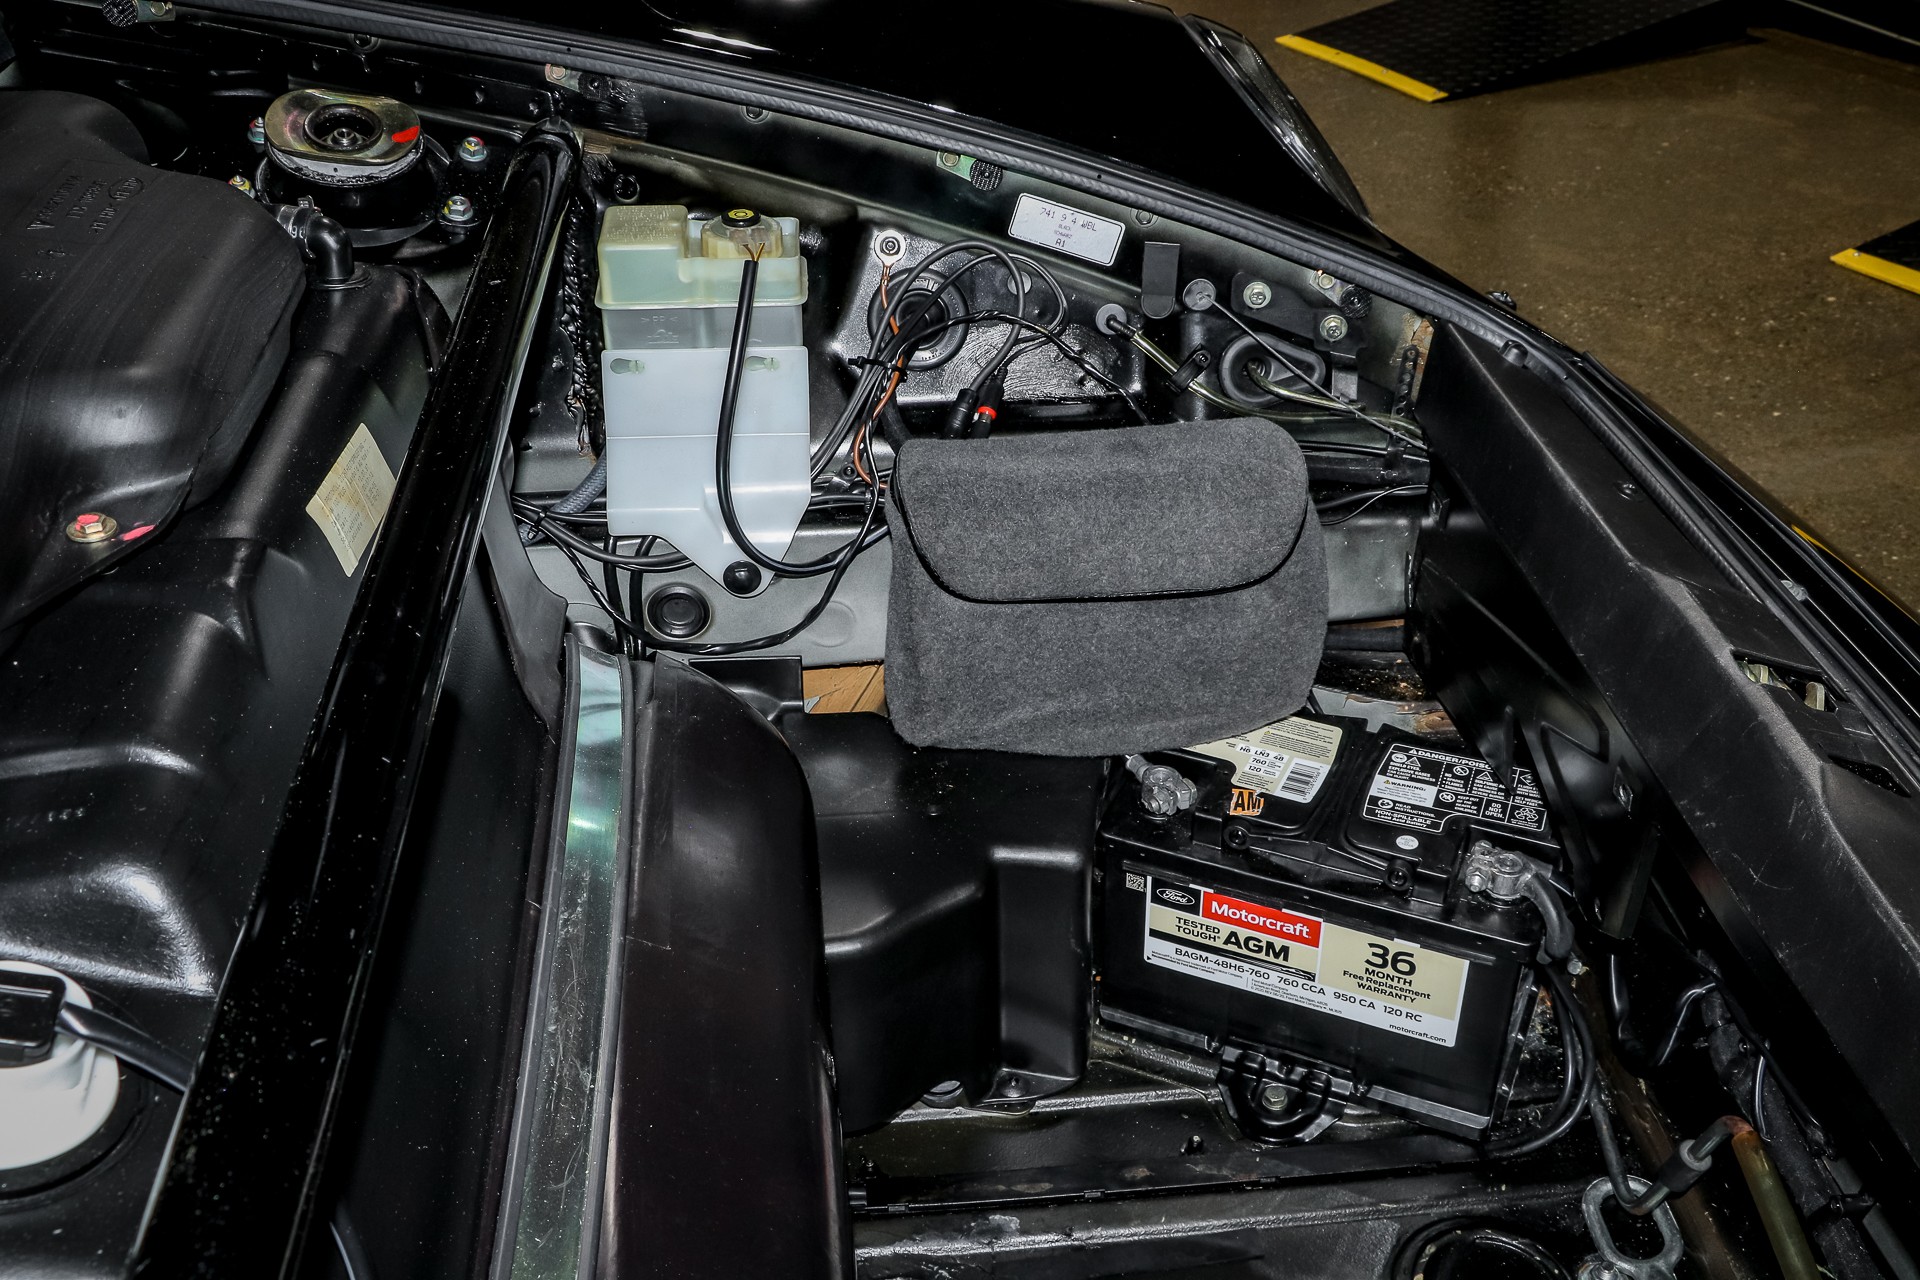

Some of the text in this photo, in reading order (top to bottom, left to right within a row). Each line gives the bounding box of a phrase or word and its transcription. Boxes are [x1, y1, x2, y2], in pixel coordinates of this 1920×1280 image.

[1040, 207, 1056, 219] 741
[1081, 220, 1097, 232] WBL
[1248, 765, 1262, 773] 120
[1252, 757, 1267, 766] 760
[1375, 809, 1432, 825] NON-SPILLABLE
[1175, 915, 1221, 935] TESTED
[1210, 900, 1311, 939] Motorcraft
[1222, 930, 1291, 963] AGM
[1364, 942, 1417, 977] 36
[1174, 946, 1423, 1023] BAGM-48H6-760 760 CCA 950 CA 120 RC
[1342, 970, 1432, 1000] Free Replacement
[1364, 967, 1413, 987] MONTH
[1356, 982, 1418, 1004] WARRANTY
[1389, 1023, 1447, 1044] motorcraft.com
